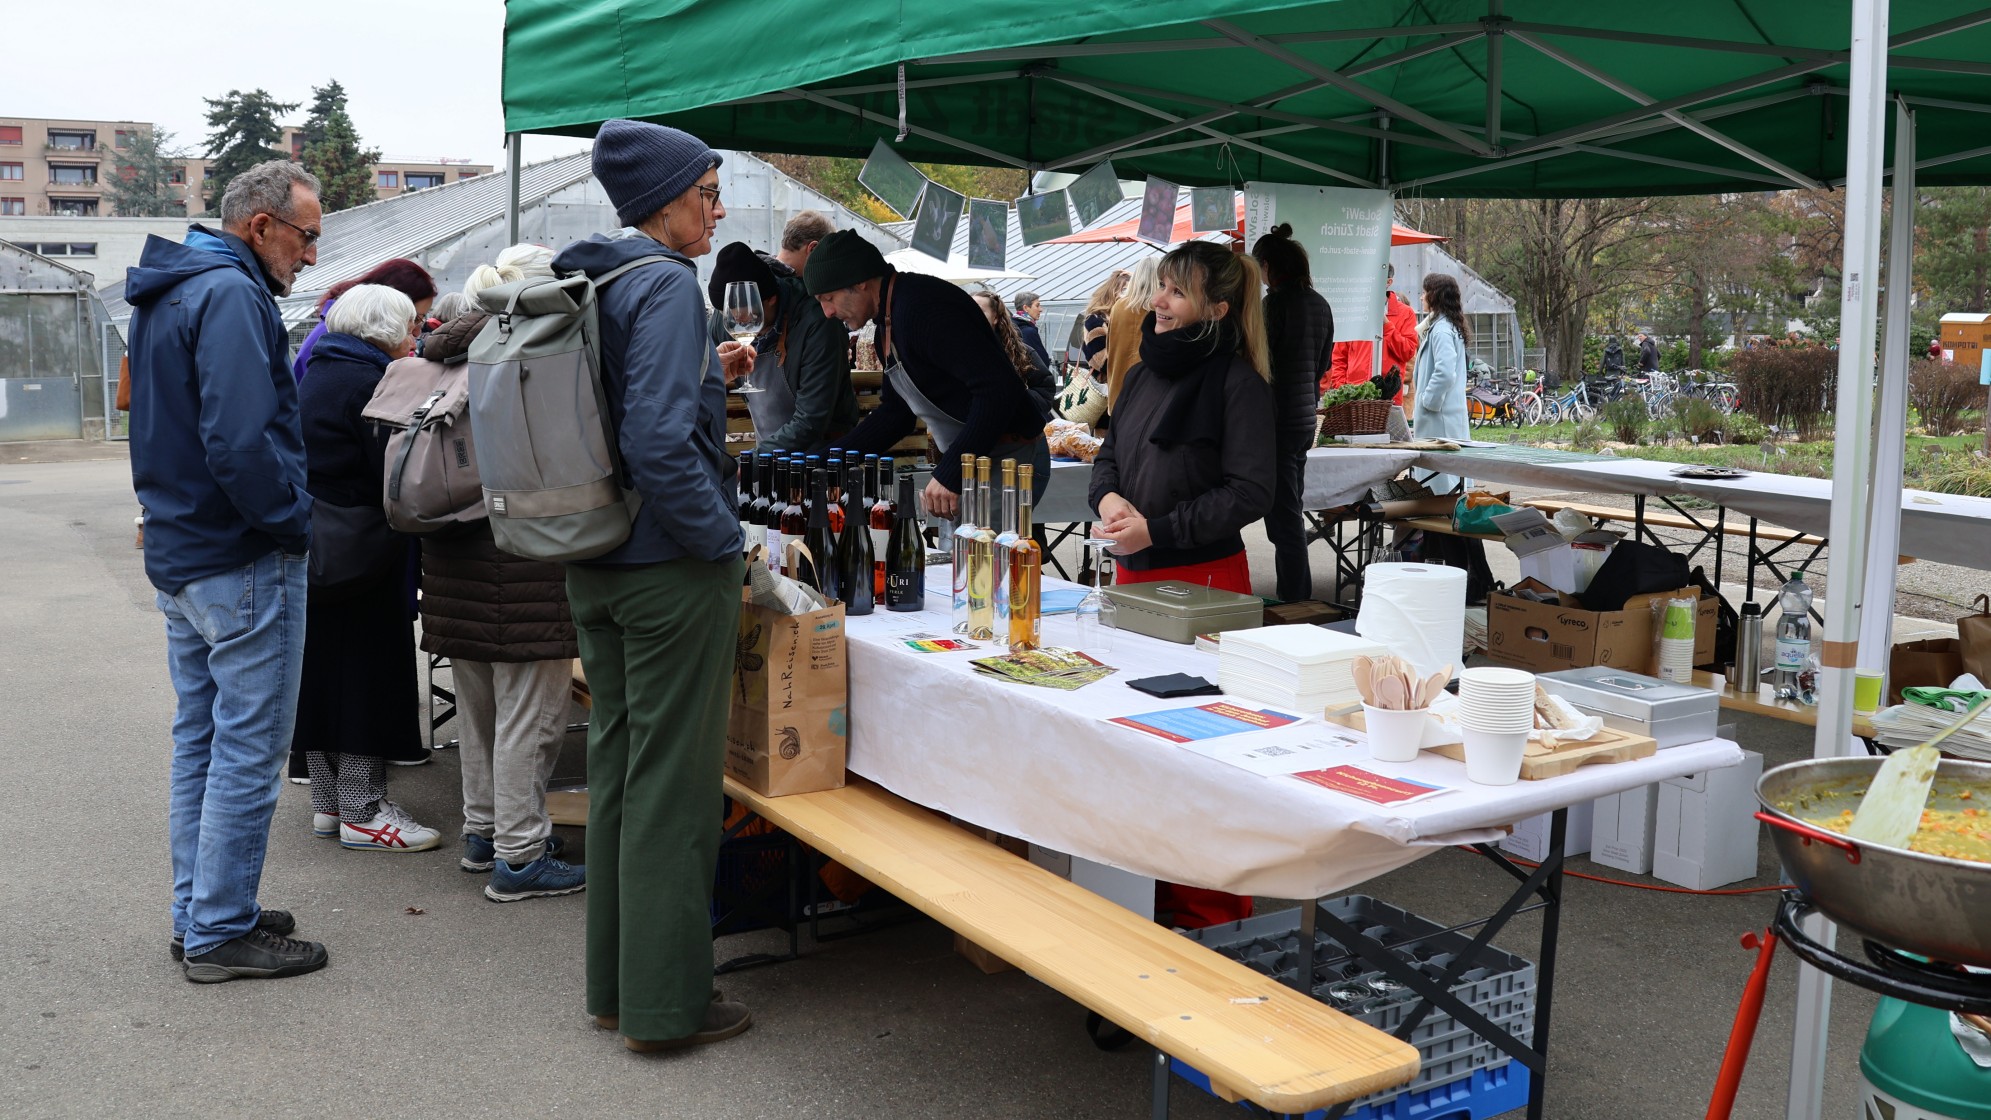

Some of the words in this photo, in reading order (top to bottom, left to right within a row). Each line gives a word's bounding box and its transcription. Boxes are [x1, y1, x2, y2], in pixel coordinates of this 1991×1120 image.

[1560, 616, 1586, 628] Lyreco
[1781, 651, 1805, 660] aquella
[781, 621, 800, 709] NahReisen.ch
